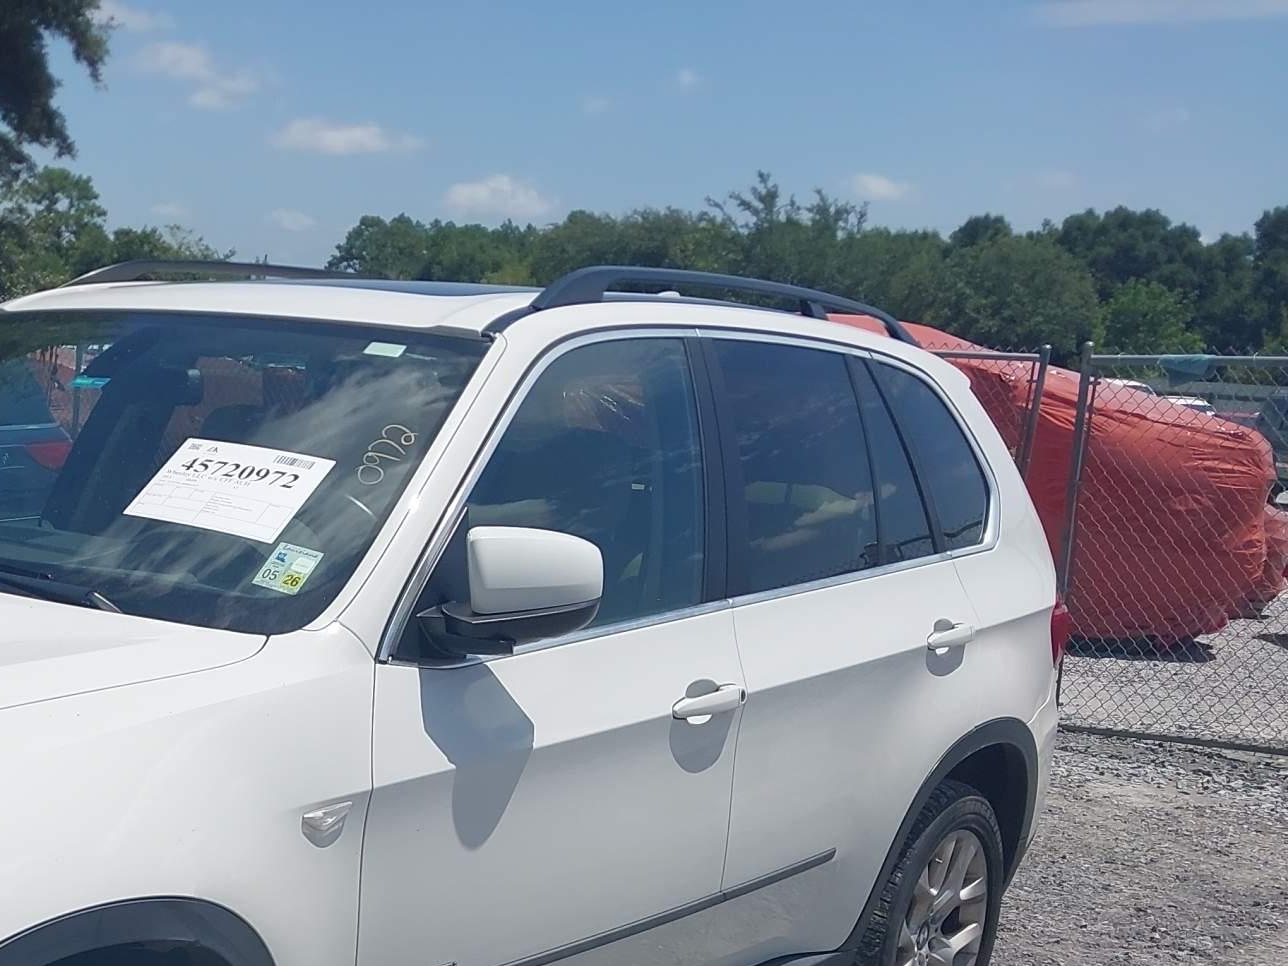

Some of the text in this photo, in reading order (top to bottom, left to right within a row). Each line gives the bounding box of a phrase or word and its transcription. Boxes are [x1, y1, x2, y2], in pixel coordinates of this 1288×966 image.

[180, 457, 301, 489] 45720972
[261, 568, 279, 581] 05
[282, 574, 301, 587] 26
